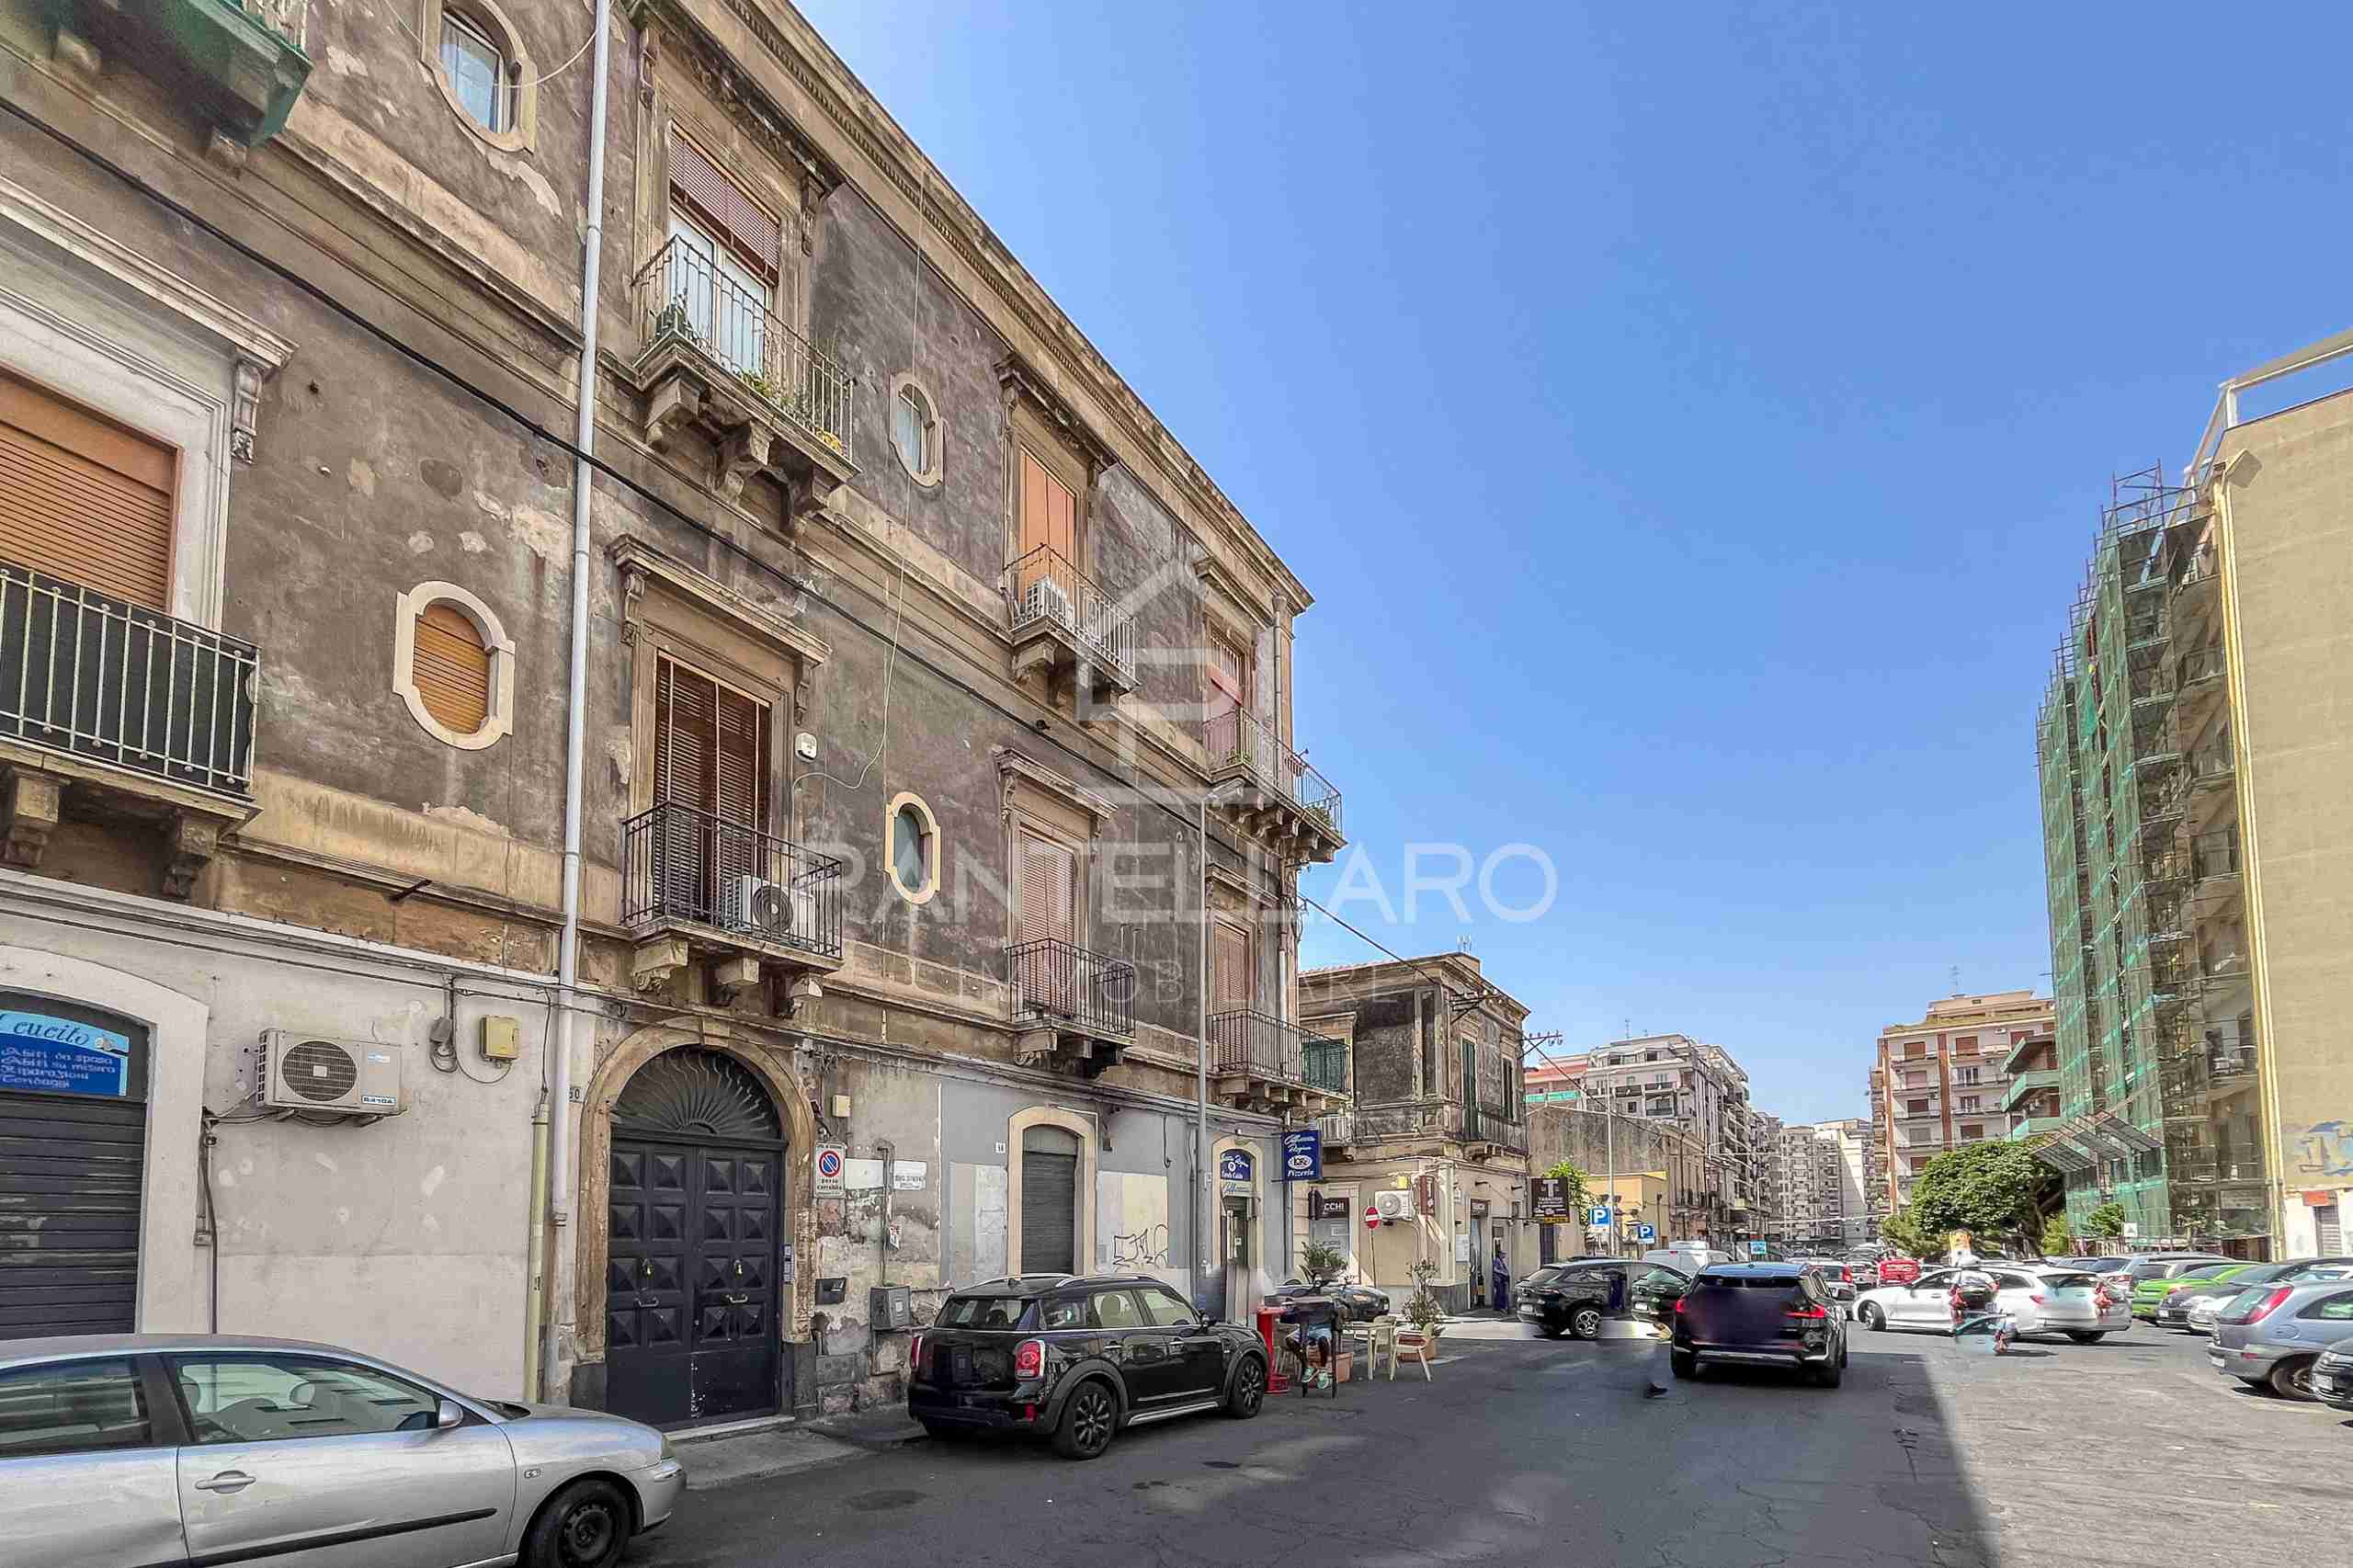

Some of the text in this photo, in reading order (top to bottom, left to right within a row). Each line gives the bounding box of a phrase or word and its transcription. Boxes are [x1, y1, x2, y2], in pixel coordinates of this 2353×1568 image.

[13, 1020, 90, 1046] cucito
[1594, 1209, 1607, 1224] P
[1641, 1226, 1651, 1238] P
